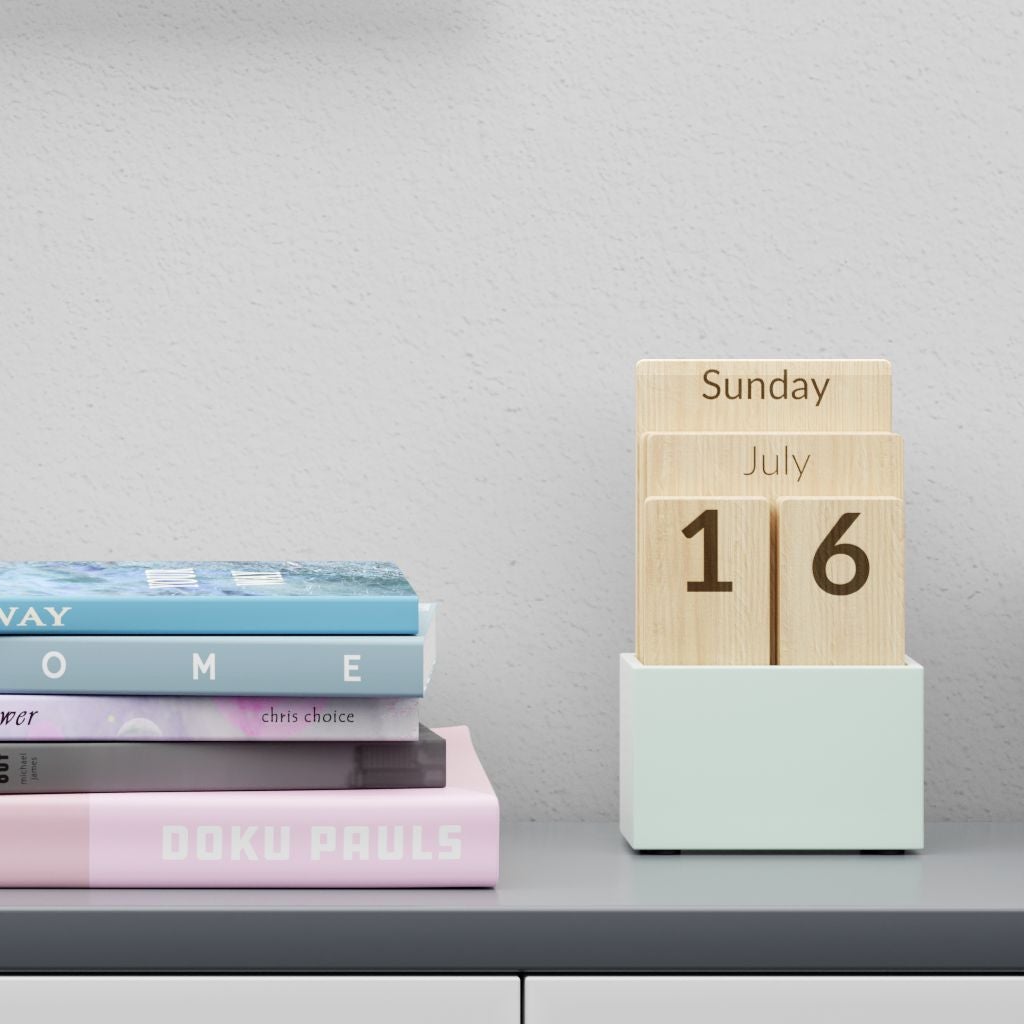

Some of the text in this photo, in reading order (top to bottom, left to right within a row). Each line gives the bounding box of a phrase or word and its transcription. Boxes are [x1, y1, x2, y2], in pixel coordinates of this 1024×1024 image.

[701, 368, 831, 407] Sunday
[743, 445, 811, 483] July
[261, 706, 355, 723] chris choice
[162, 824, 462, 862] DOKU PAULS
